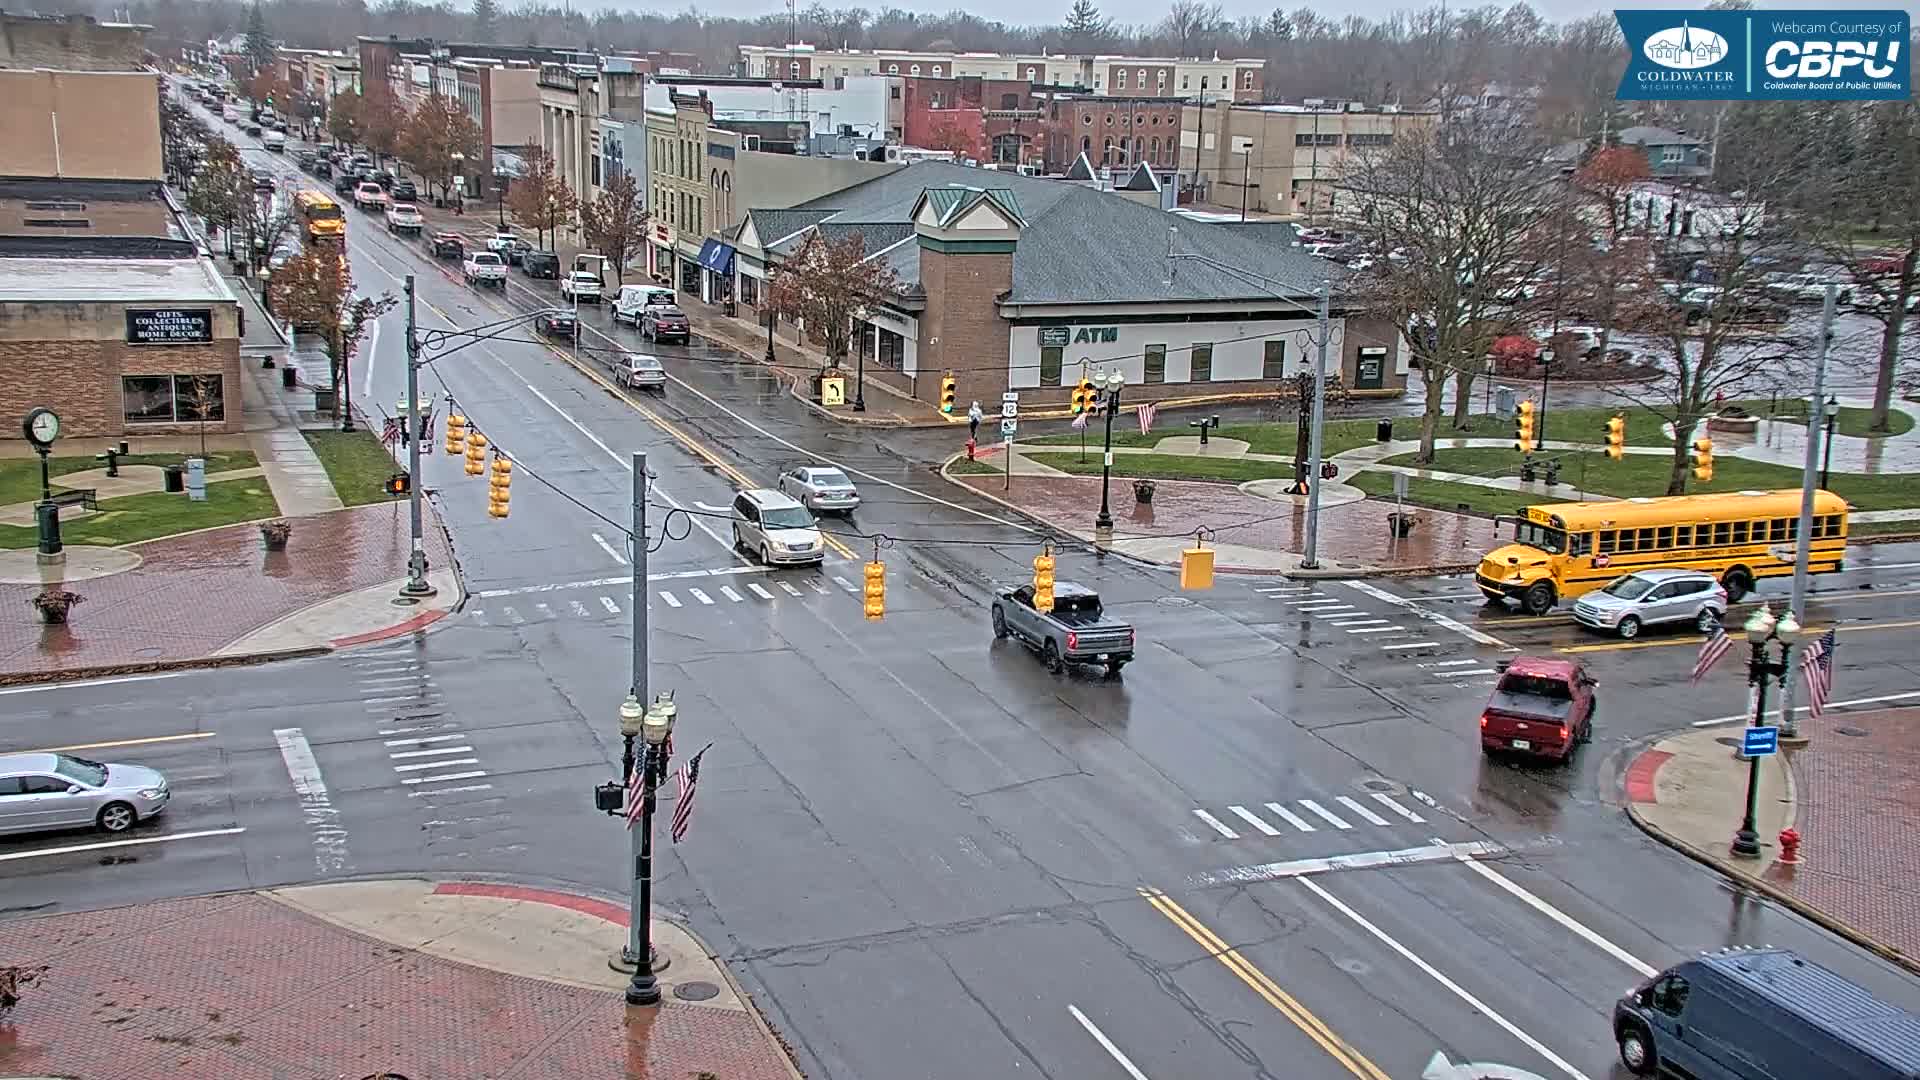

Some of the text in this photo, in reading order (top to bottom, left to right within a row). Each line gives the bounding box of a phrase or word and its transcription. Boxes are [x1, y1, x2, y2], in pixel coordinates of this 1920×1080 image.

[135, 317, 204, 325] COLLECTIBLES
[147, 324, 193, 332] ANTIQUES
[1074, 327, 1118, 344] ATM
[1005, 404, 1016, 415] 12
